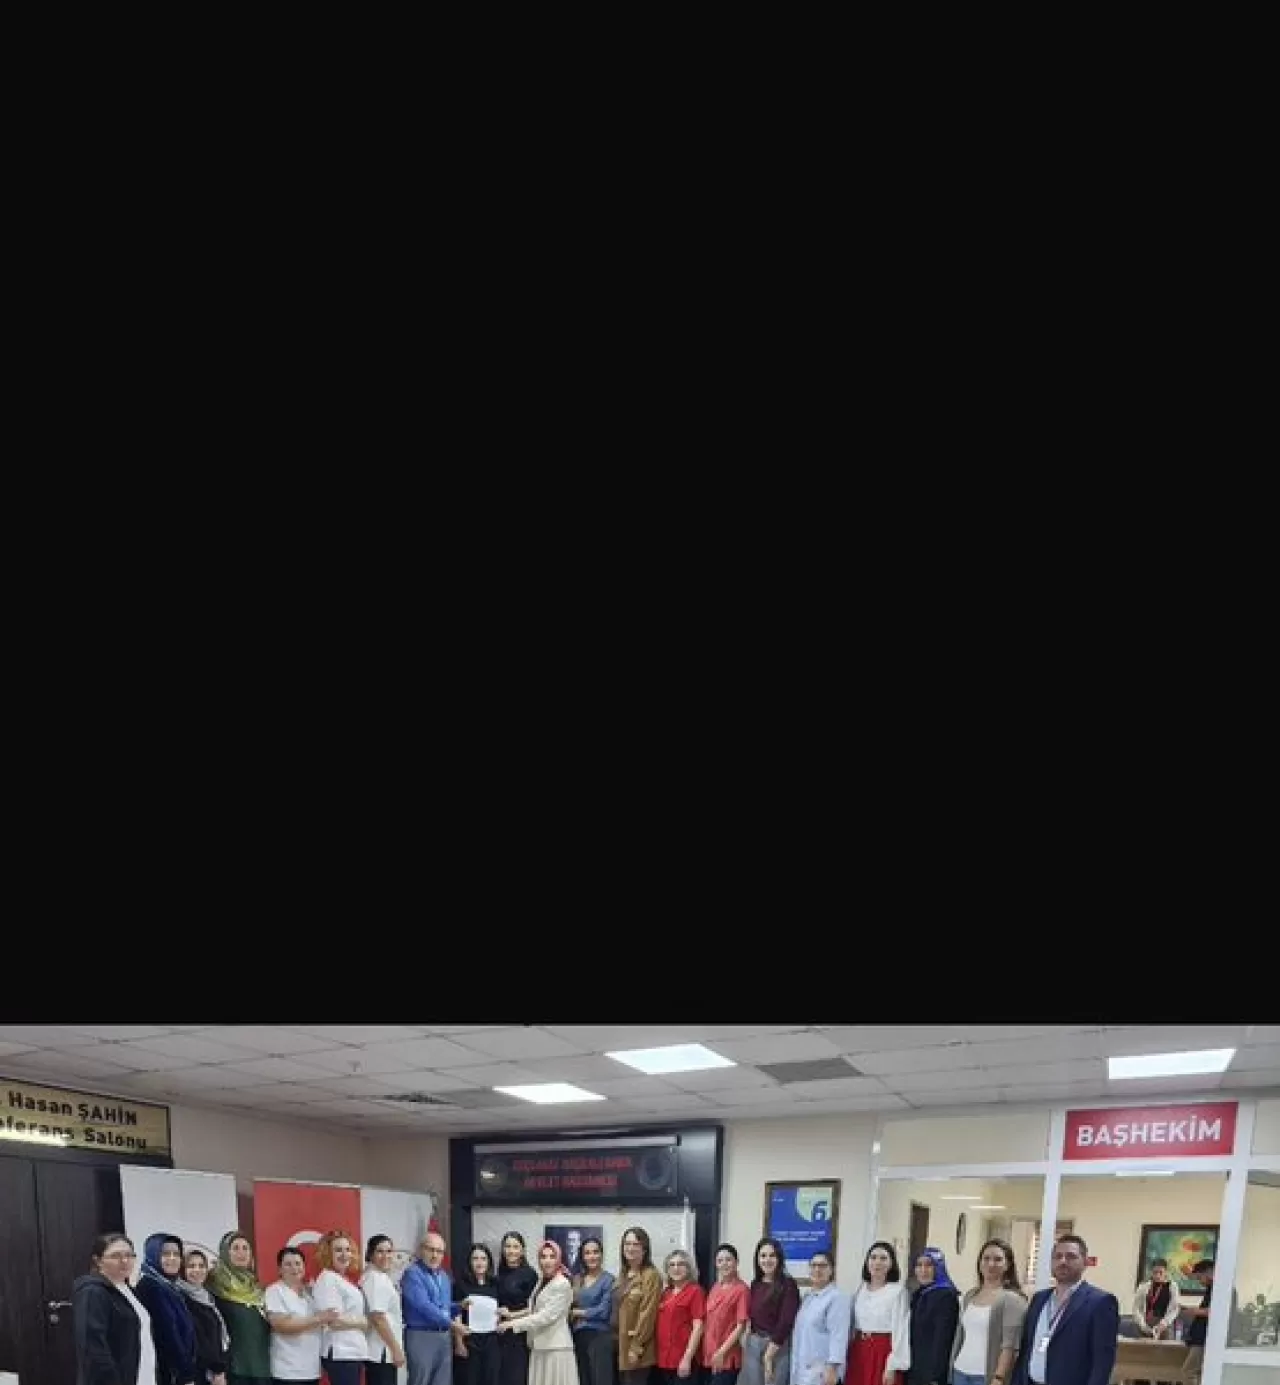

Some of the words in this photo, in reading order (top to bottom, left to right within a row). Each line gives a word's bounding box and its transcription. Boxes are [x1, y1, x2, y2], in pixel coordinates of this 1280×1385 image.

[8, 1090, 73, 1116] Hasan
[78, 1103, 137, 1126] ŞAHİN
[83, 1127, 147, 1149] Salonu
[1076, 1115, 1221, 1148] BAŞHEKİM
